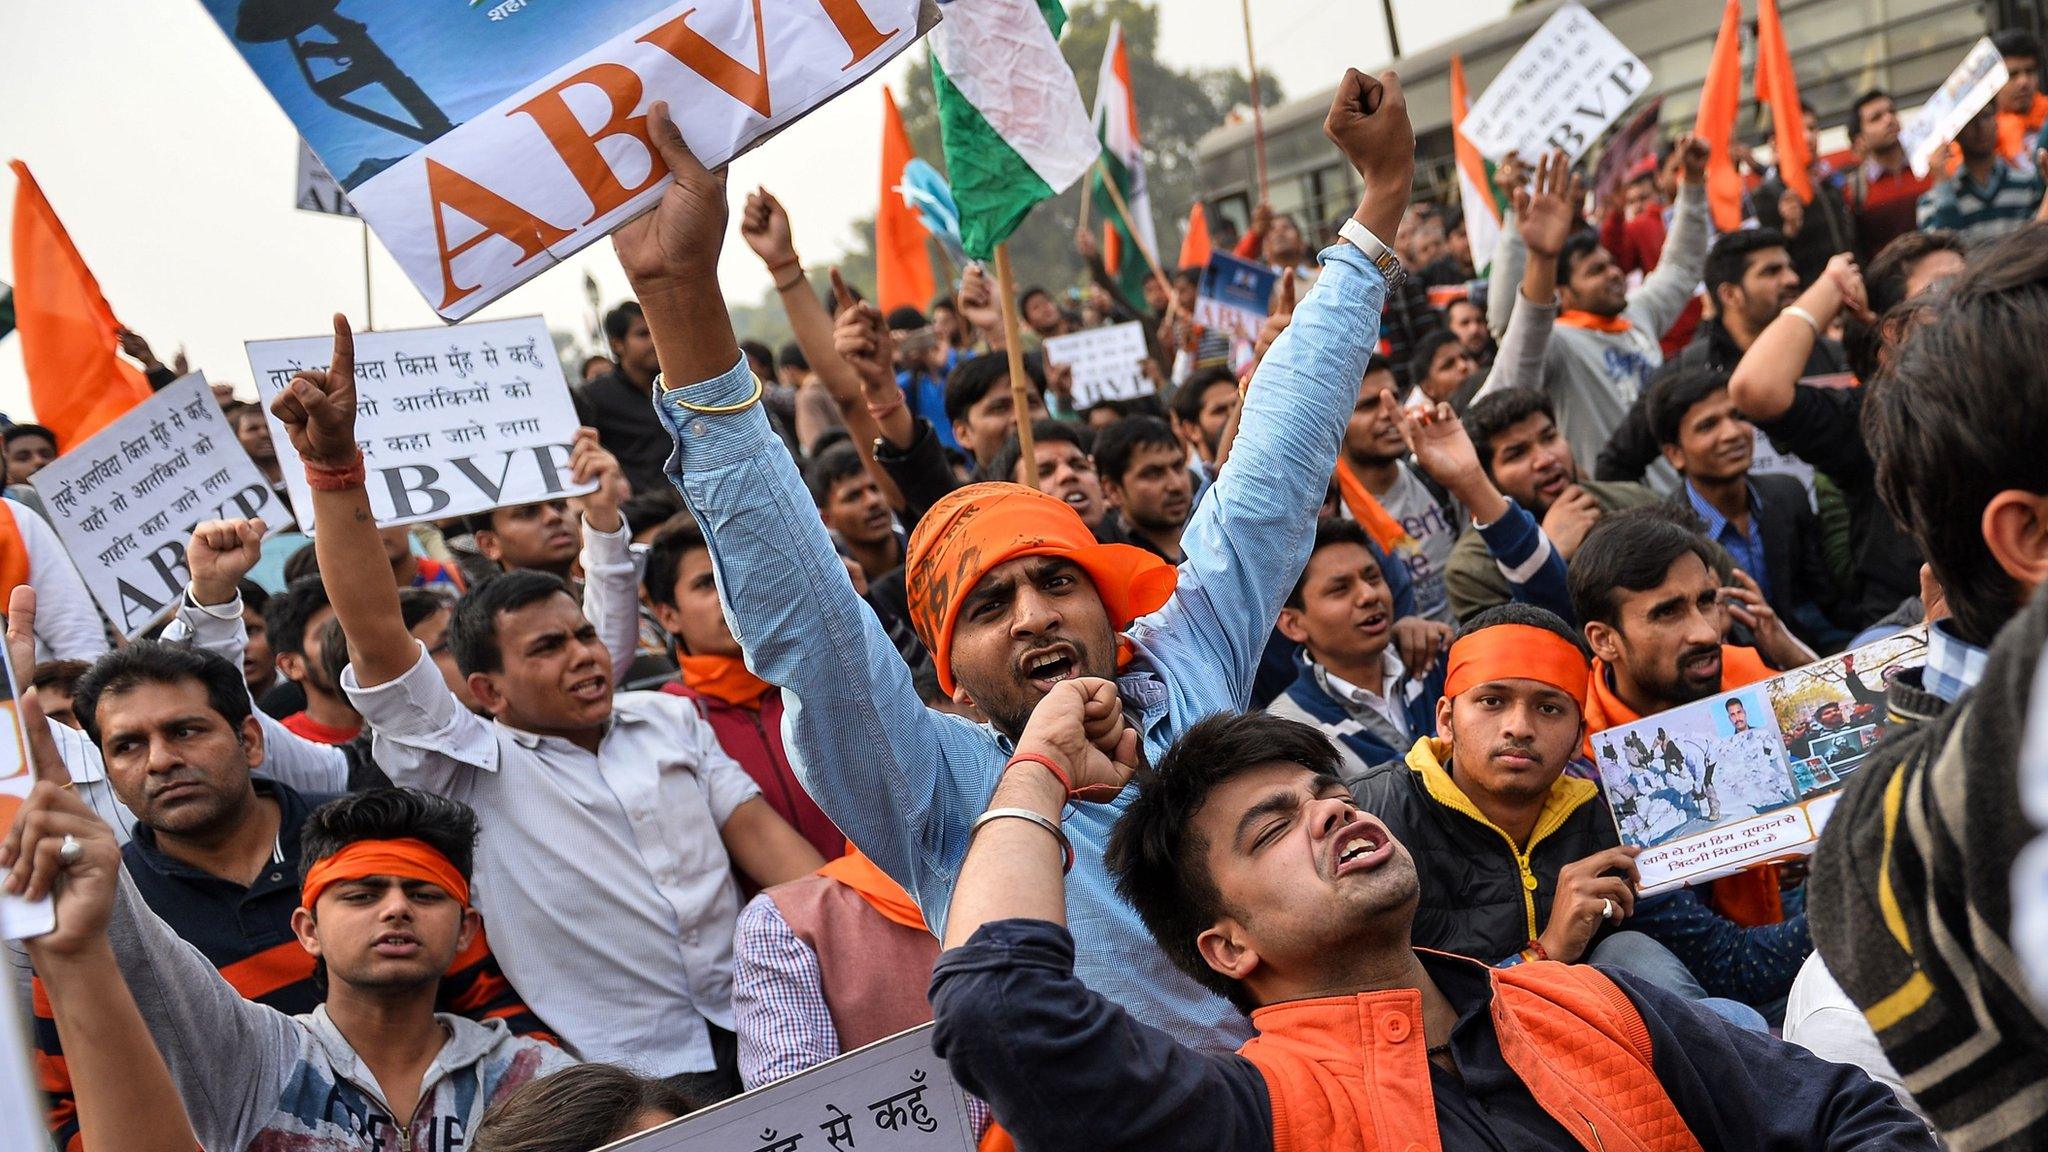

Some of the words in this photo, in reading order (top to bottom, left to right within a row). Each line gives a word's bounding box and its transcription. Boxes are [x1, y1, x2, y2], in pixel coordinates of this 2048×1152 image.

[394, 351, 438, 377] किस
[445, 344, 474, 378] मुँह
[480, 341, 499, 369] से
[393, 381, 490, 412] आतंकियों
[501, 376, 533, 399] को
[75, 453, 122, 496] अलविदा
[120, 435, 150, 465] किस
[169, 408, 185, 432] से
[383, 432, 431, 453] कहा
[441, 419, 486, 445] जाने
[496, 417, 541, 437] लगा
[109, 491, 128, 515] तो
[131, 447, 191, 500] आतंकियों
[191, 432, 215, 456] को
[97, 532, 140, 568] शहीद
[138, 510, 170, 538] कहा
[171, 486, 200, 515] जाने
[201, 467, 232, 497] लगा
[819, 1104, 855, 1152] से
